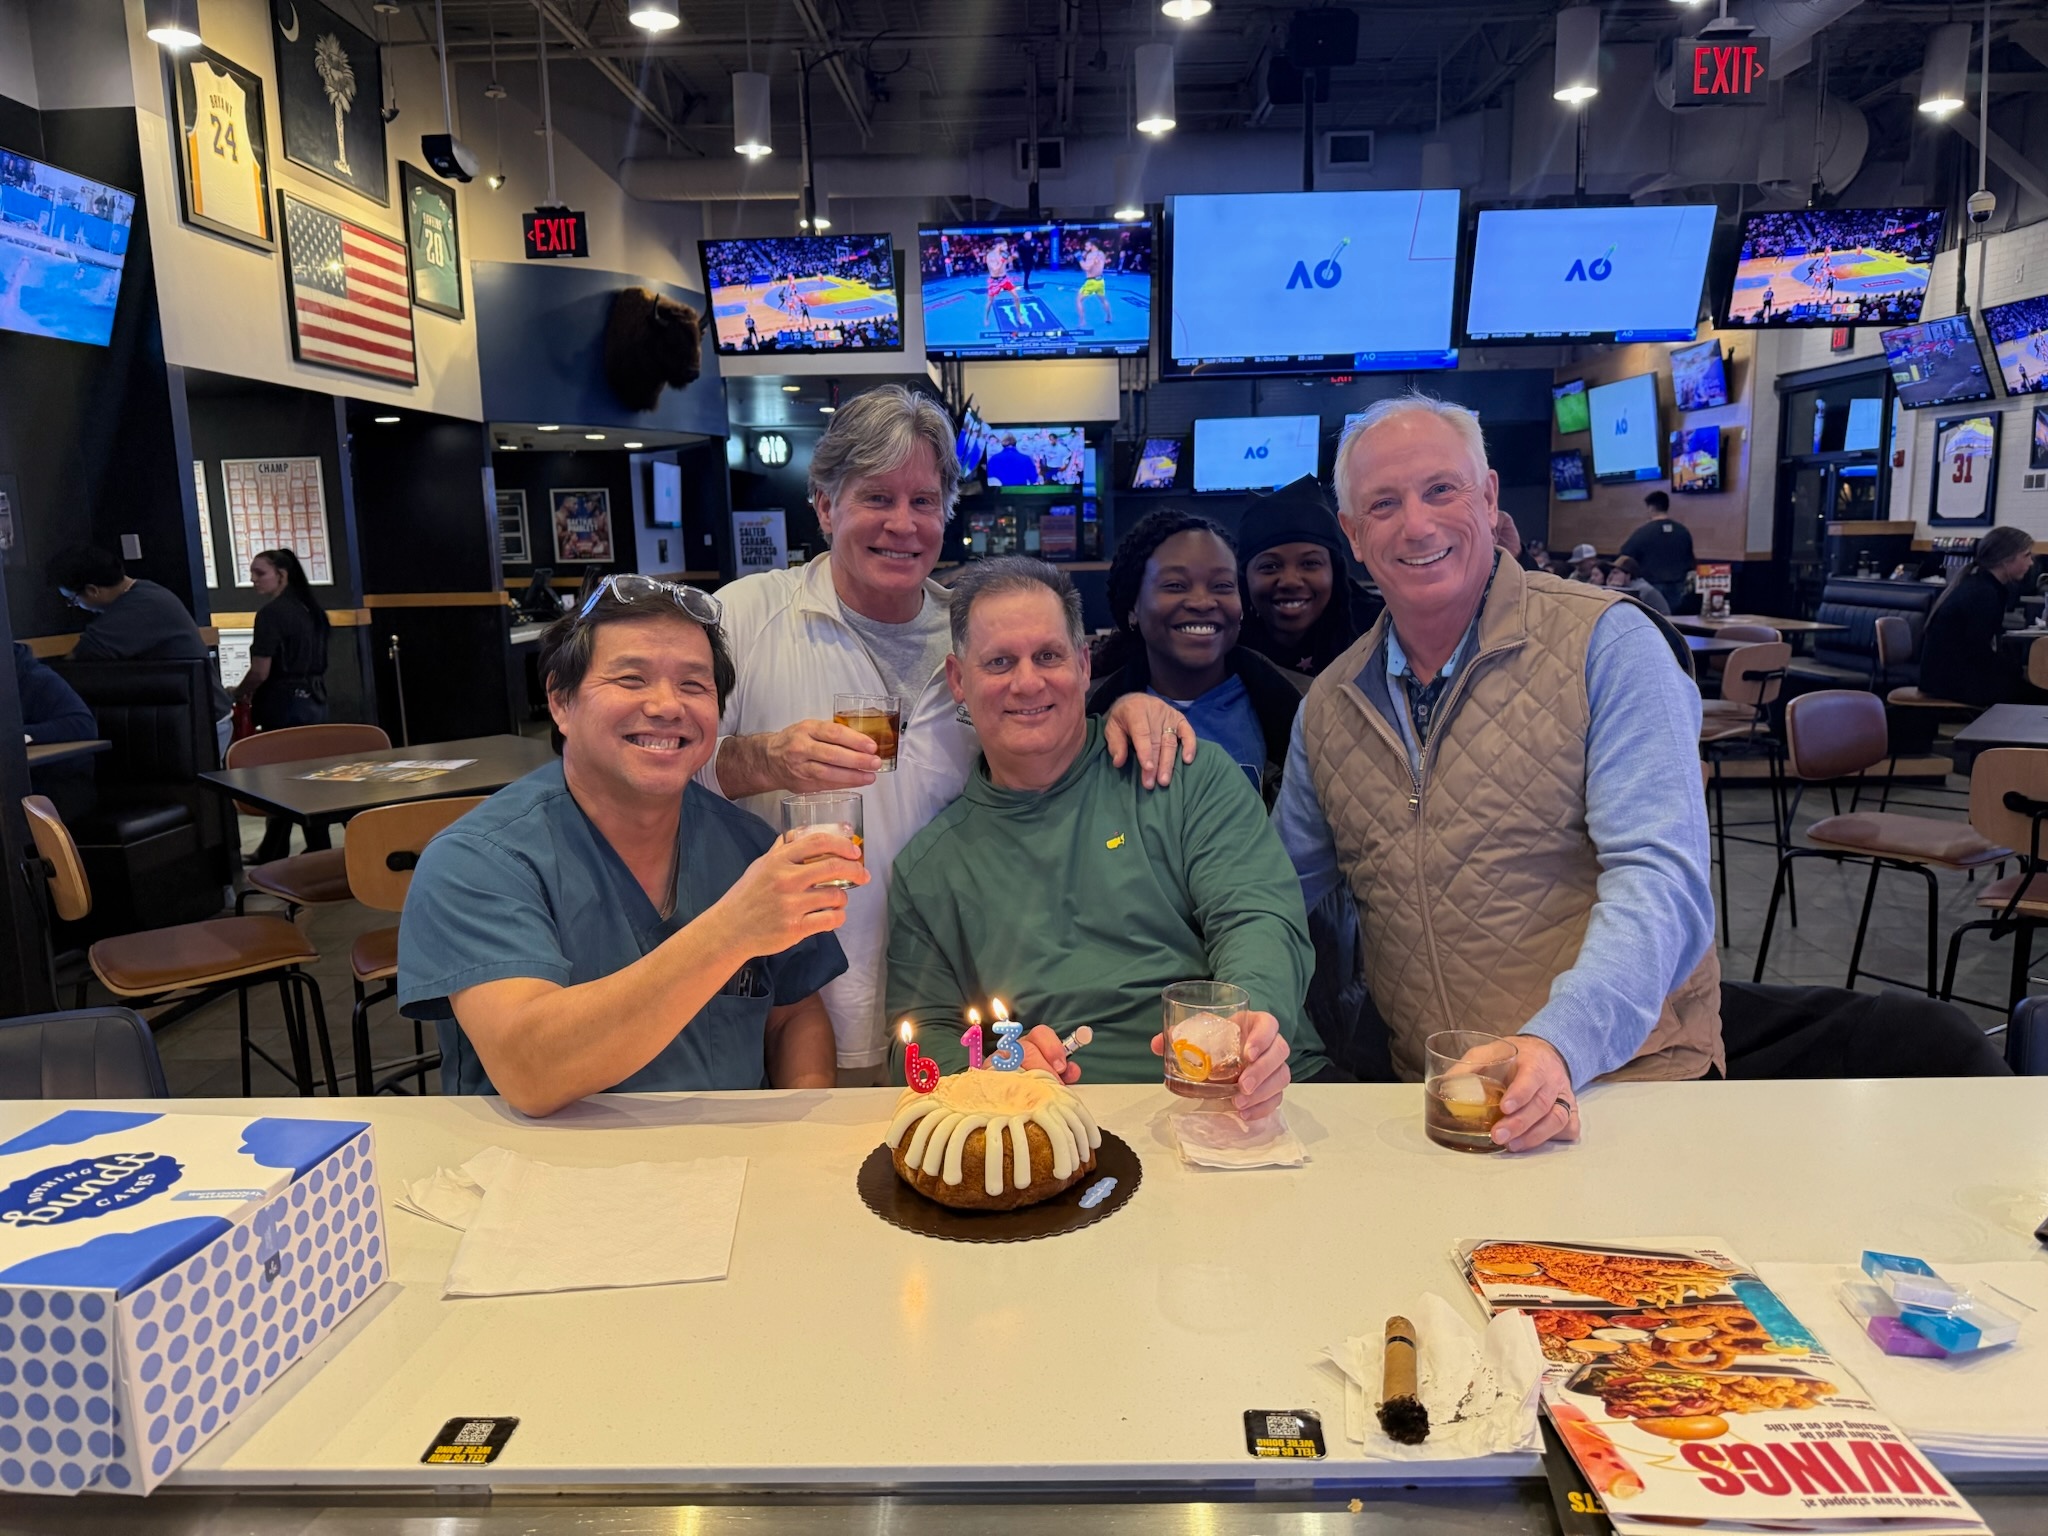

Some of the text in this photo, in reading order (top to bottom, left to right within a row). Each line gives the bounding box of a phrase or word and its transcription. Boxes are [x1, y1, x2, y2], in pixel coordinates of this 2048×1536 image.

[1693, 46, 1757, 94] EXIT
[209, 94, 232, 117] BRYANT
[210, 112, 238, 163] 24
[534, 218, 577, 251] EXIT
[425, 228, 444, 267] 20
[1243, 446, 1269, 459] AO
[258, 463, 289, 473] CHAMP
[1952, 453, 1972, 483] 31
[739, 527, 766, 536] SALTED
[741, 537, 773, 546] CARAMEL
[741, 546, 777, 555] ESPRESSO
[742, 556, 773, 565] MARTINI
[905, 1042, 939, 1093] 6
[2, 1153, 160, 1223] bundt
[27, 1168, 92, 1204] NOTHING
[95, 1173, 156, 1207] CAKES
[1764, 1420, 1890, 1432] missing out on all this
[1799, 1430, 1900, 1441] but then you'd be
[1256, 1438, 1315, 1447] WE'RE DOING
[463, 1446, 493, 1454] WE'RE
[1256, 1447, 1317, 1456] TELL US HOW
[427, 1454, 487, 1463] TELL US HOW
[1680, 1441, 1951, 1497] WINGS
[1801, 1496, 1961, 1508] we could have stopped at
